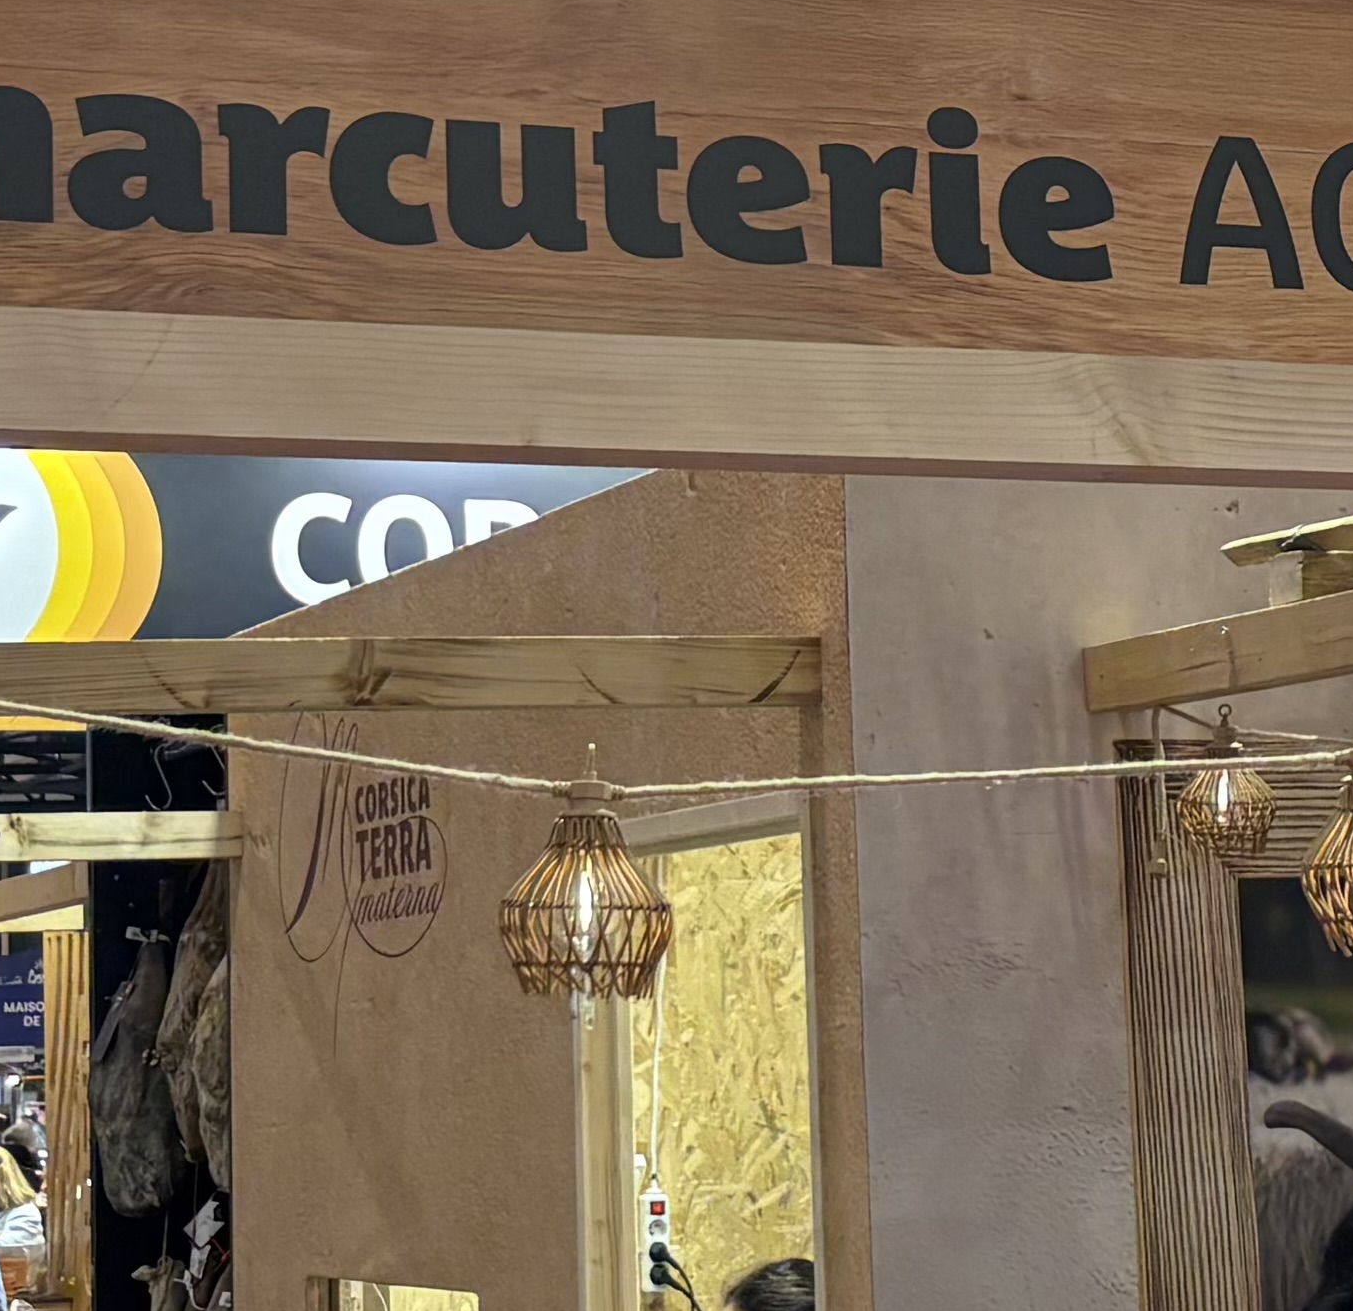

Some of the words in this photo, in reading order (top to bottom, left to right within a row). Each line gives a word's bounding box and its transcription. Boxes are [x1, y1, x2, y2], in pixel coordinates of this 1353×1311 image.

[355, 775, 431, 825] CORSICA
[355, 819, 432, 882] TERRA
[357, 881, 442, 925] materna
[3, 1001, 44, 1013] MAISO
[23, 1015, 41, 1027] DE
